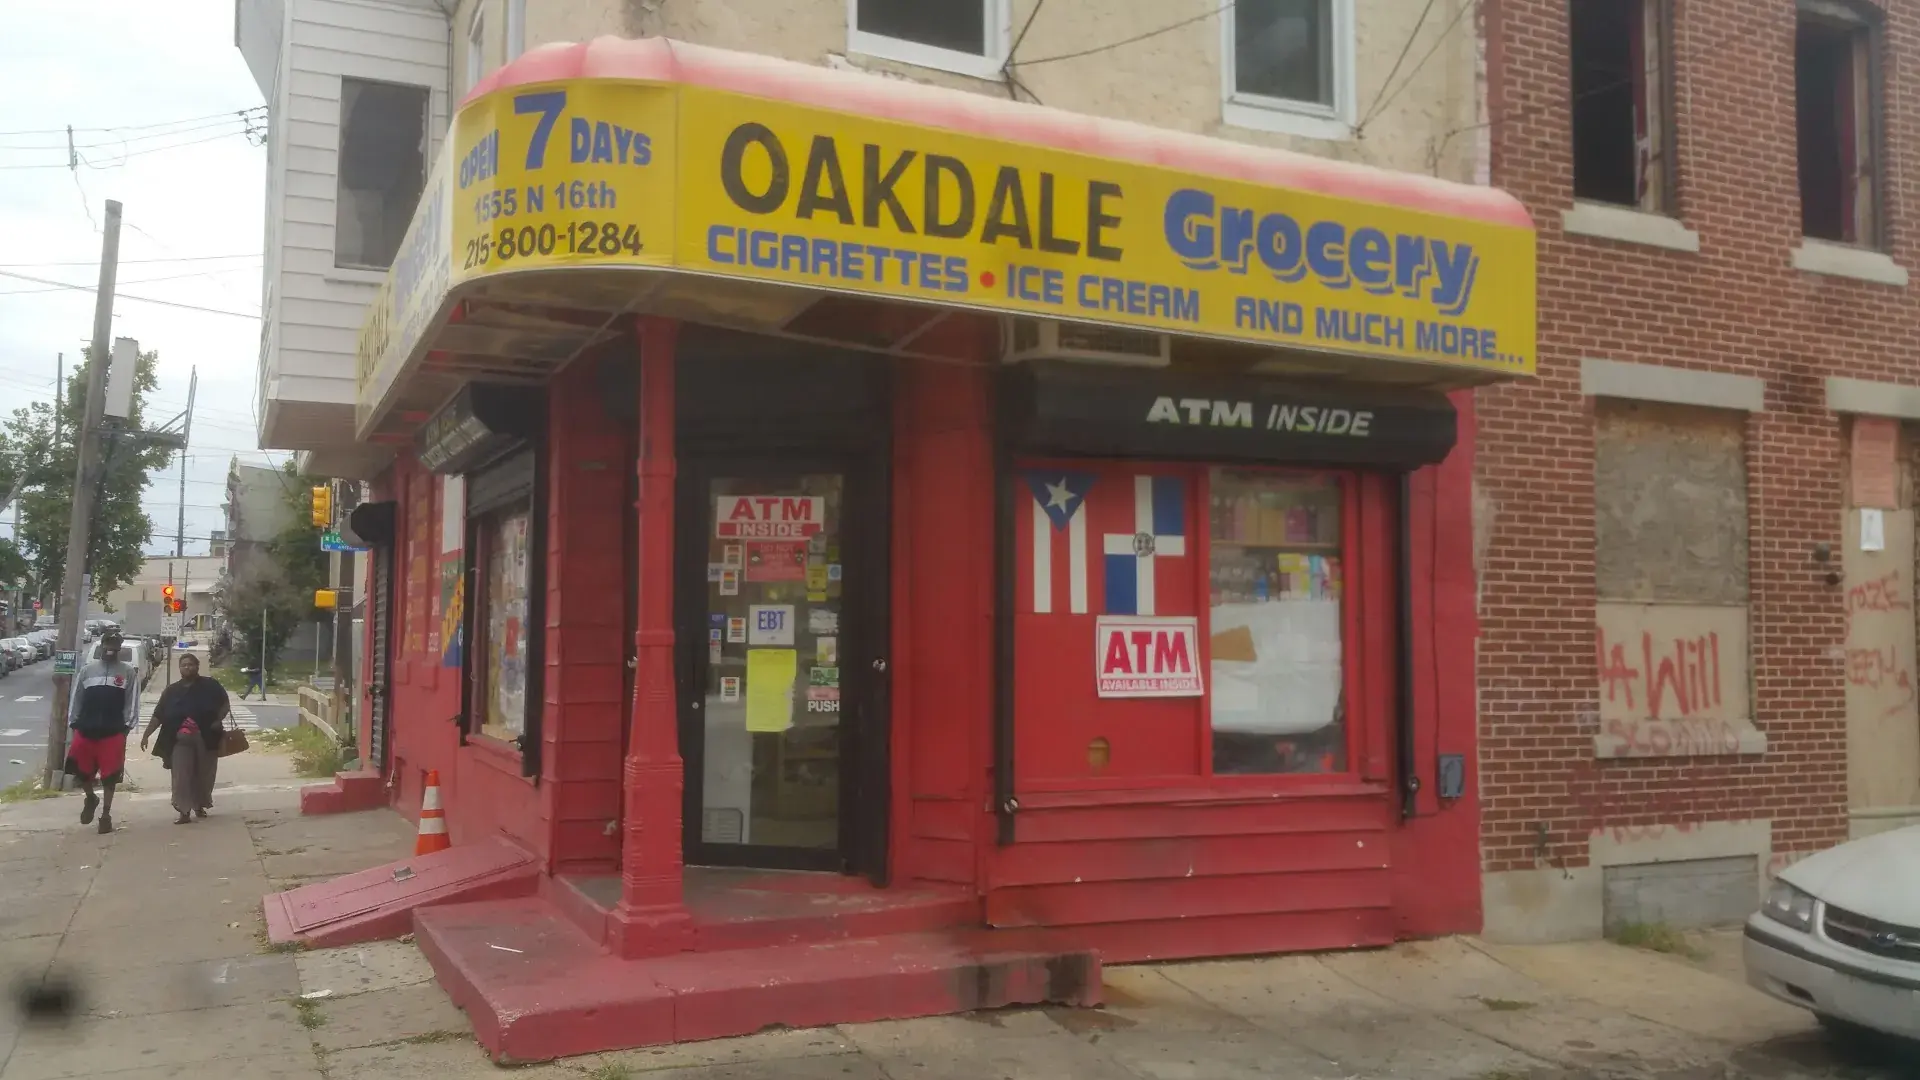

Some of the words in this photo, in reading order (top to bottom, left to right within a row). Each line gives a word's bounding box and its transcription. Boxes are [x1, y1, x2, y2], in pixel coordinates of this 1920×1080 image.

[459, 128, 499, 189] OPEN
[513, 90, 567, 170] 7
[570, 117, 652, 166] DAYS
[474, 189, 518, 224] 1555
[526, 184, 545, 214] N
[555, 179, 617, 210] 16th
[720, 122, 1124, 263] OAKDALE
[1163, 188, 1479, 316] Grocery
[464, 221, 643, 271] 215-800-1284
[707, 224, 969, 293] CIGARETTES
[1007, 263, 1064, 305] ICE
[1077, 274, 1200, 322] CREAM
[1234, 296, 1304, 335] AND
[1315, 306, 1404, 349] MUCH
[1146, 396, 1253, 428] ATM
[1266, 404, 1374, 437] INSIDE
[729, 497, 812, 521] ATM
[735, 522, 803, 537] INSIDE
[757, 610, 786, 630] EBT
[1103, 631, 1191, 673] ATM
[1102, 678, 1158, 690] AVAILABLE
[807, 700, 840, 712] PUSH
